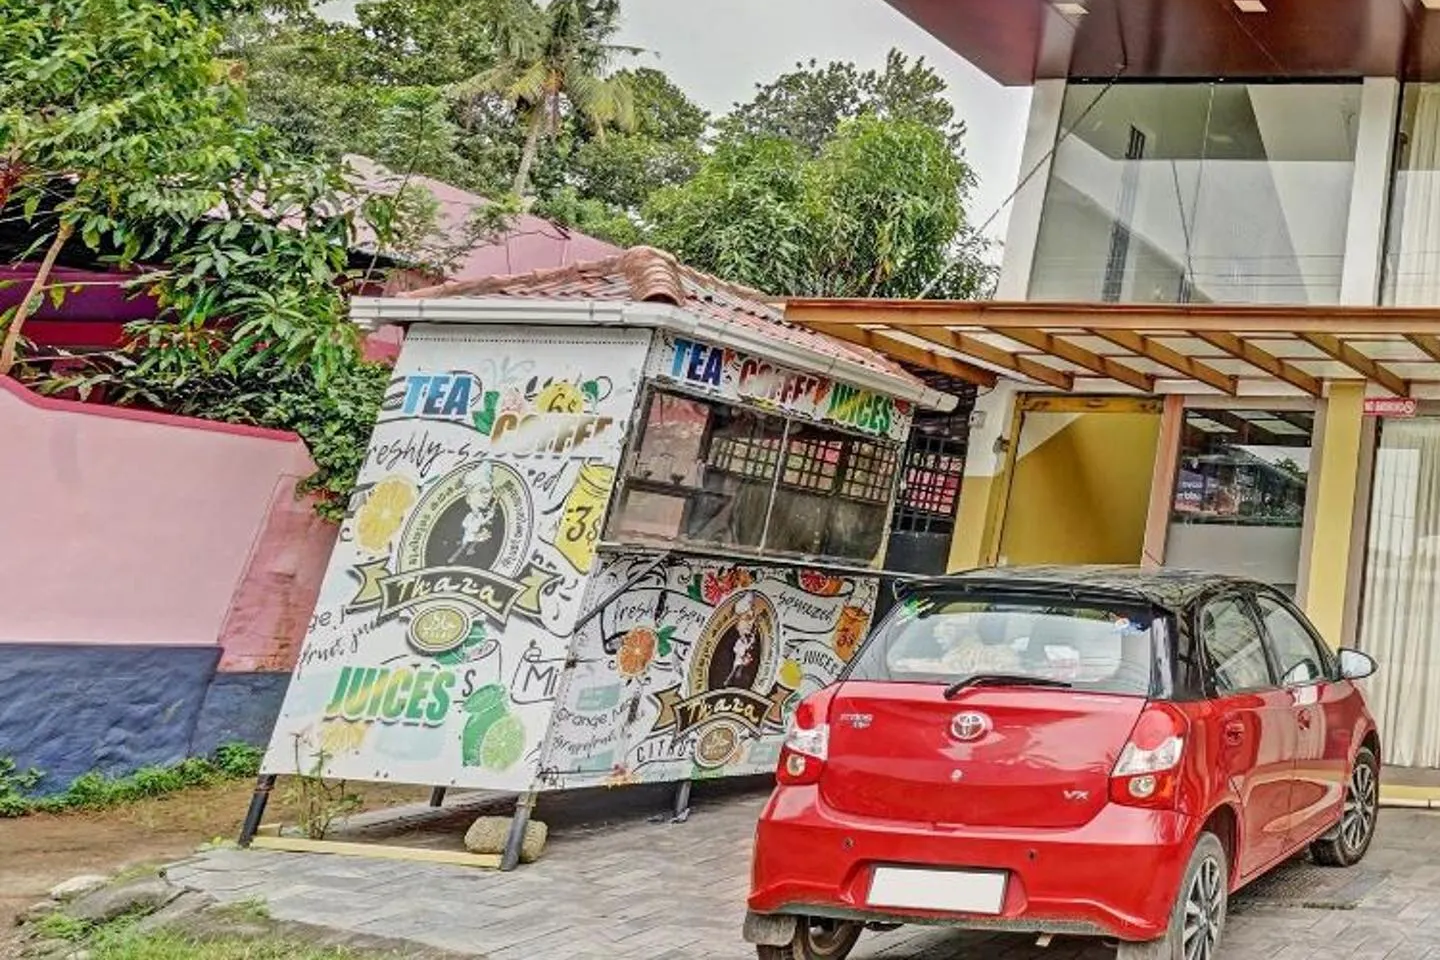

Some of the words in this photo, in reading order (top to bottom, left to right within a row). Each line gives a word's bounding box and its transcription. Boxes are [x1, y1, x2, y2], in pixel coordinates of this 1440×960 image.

[671, 338, 724, 386] TEA
[402, 374, 475, 416] TEA
[325, 666, 456, 724] JUICES
